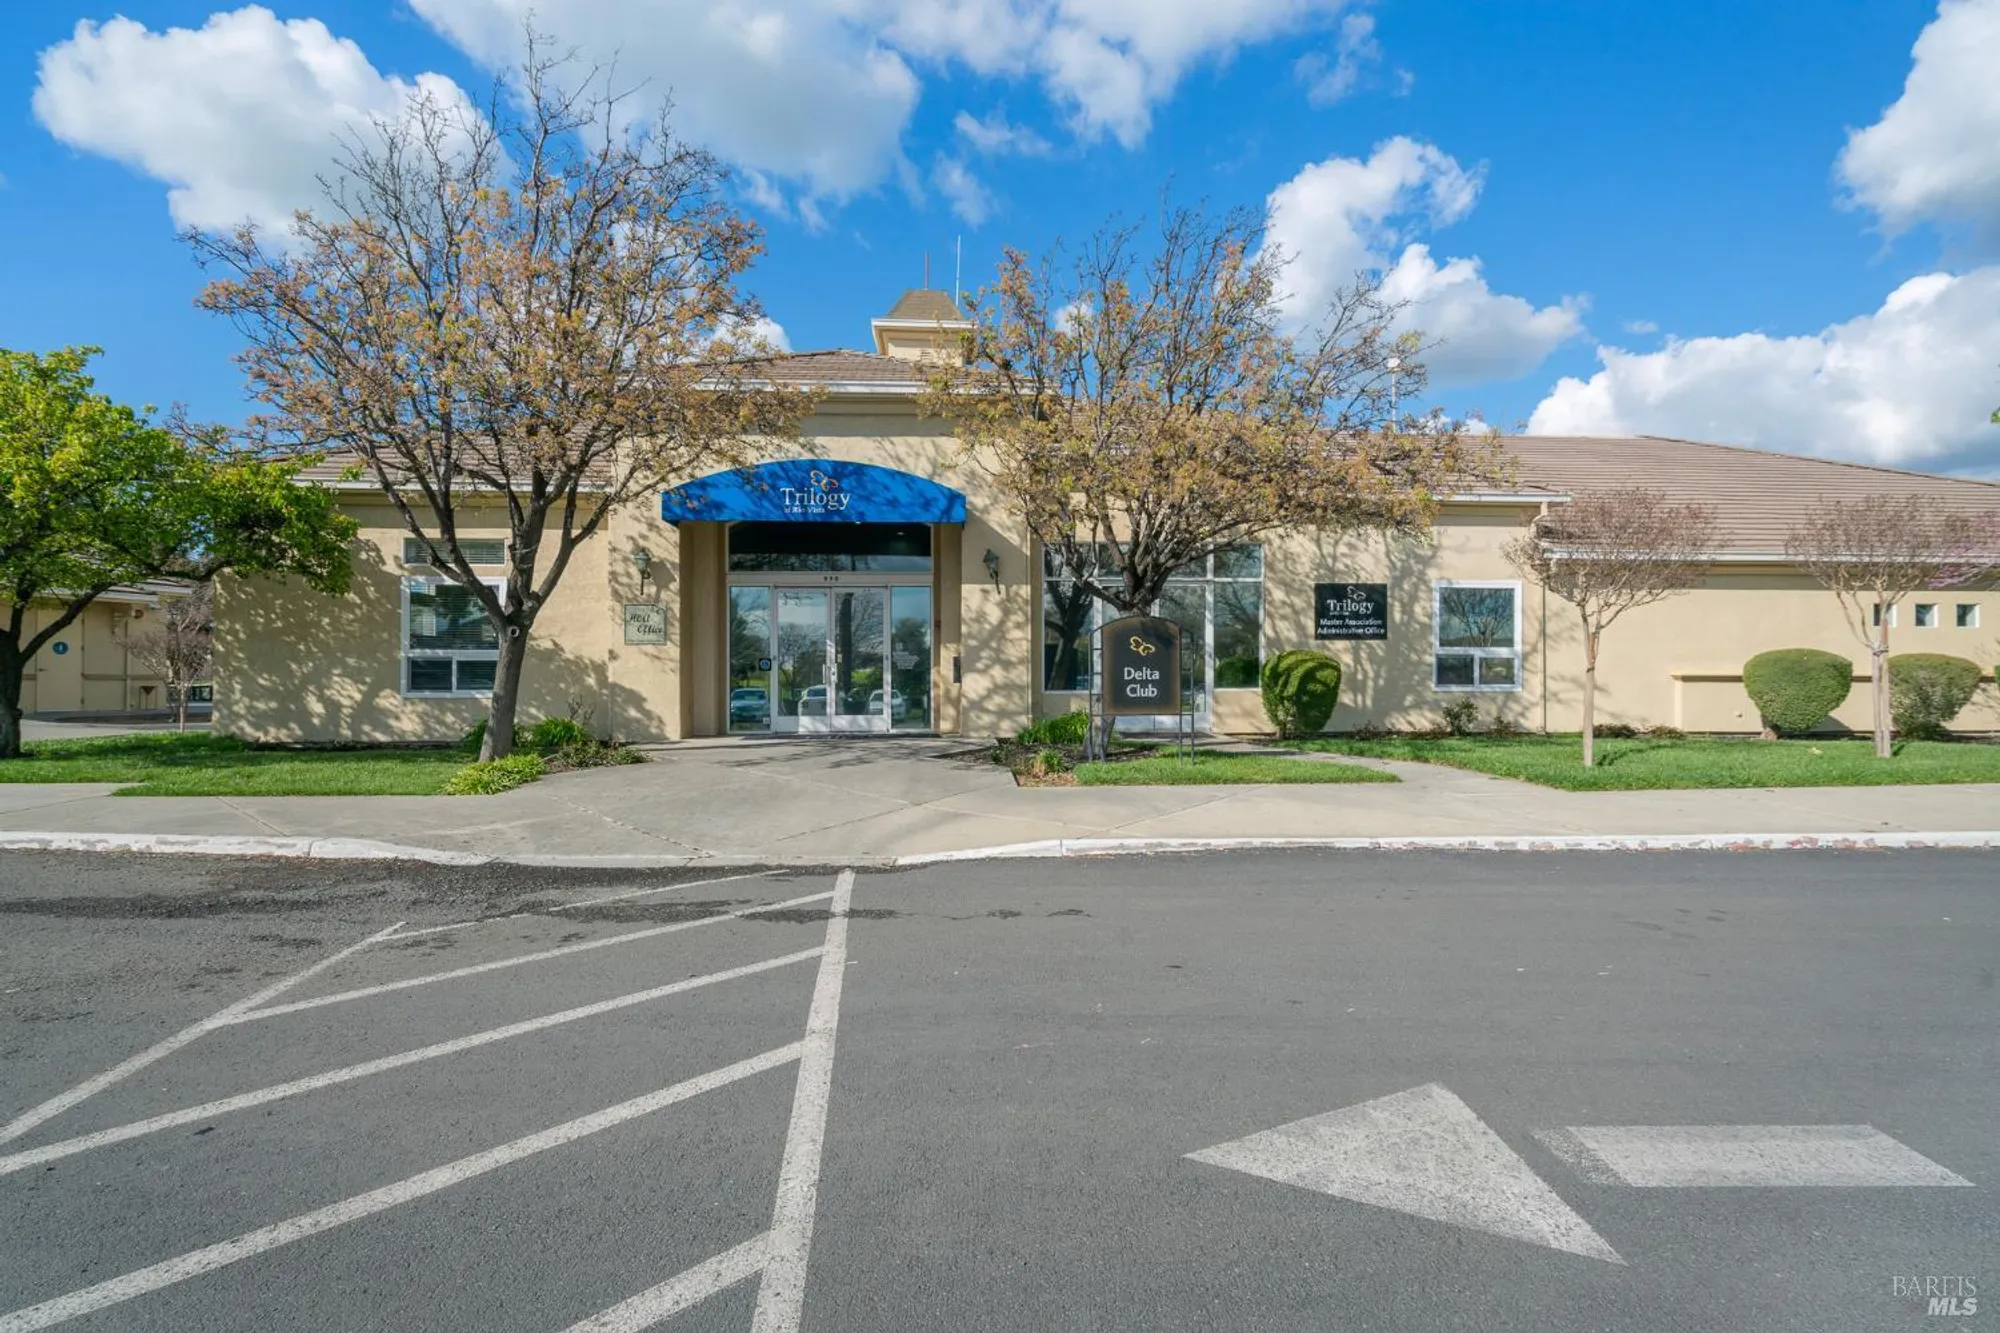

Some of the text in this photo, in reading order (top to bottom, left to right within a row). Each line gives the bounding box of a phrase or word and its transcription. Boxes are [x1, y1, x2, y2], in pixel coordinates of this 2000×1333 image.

[780, 488, 851, 510] Trilogy
[1326, 599, 1375, 614] Trilogy
[1344, 618, 1382, 626] Association
[1364, 626, 1385, 635] Office
[1123, 666, 1160, 680] Delta
[1126, 684, 1158, 697] Club
